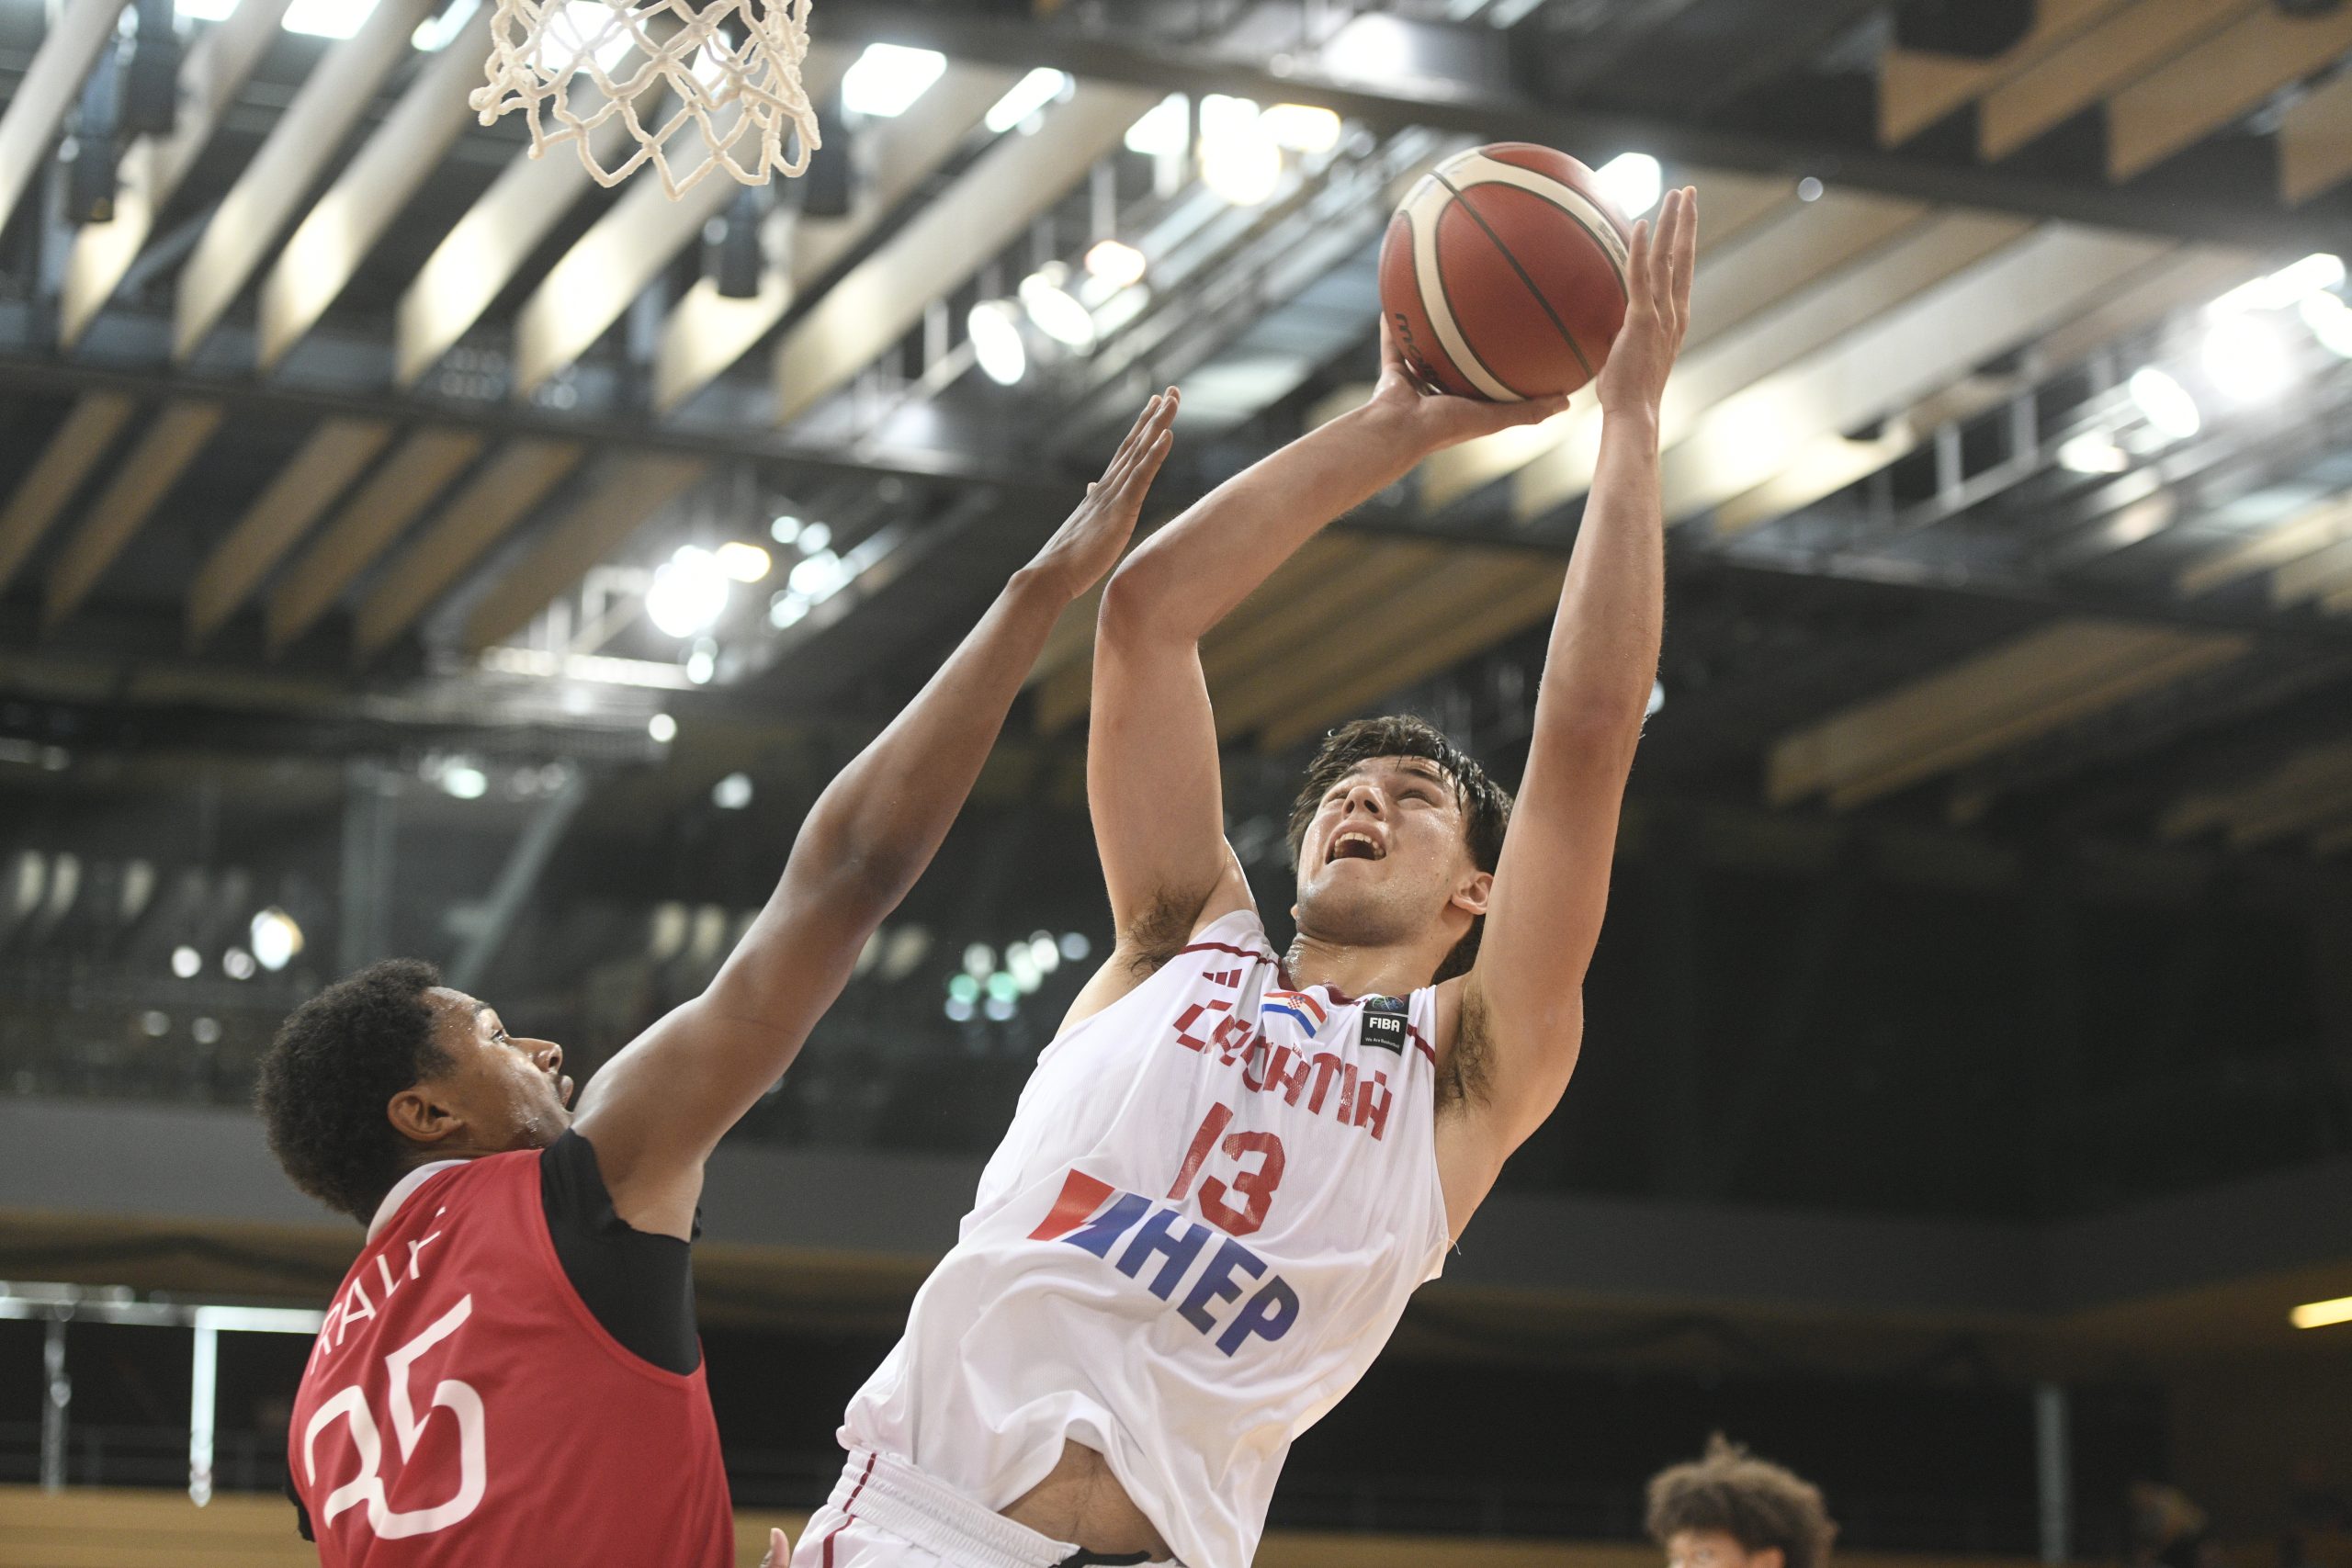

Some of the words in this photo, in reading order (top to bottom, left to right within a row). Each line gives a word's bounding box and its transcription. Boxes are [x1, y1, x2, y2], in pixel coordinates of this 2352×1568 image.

[1172, 998, 1393, 1142] CROATIA
[1369, 1017, 1401, 1032] FIBA
[1166, 1101, 1286, 1236] 13
[1114, 1209, 1300, 1357] HEP
[303, 1292, 487, 1540] 25
